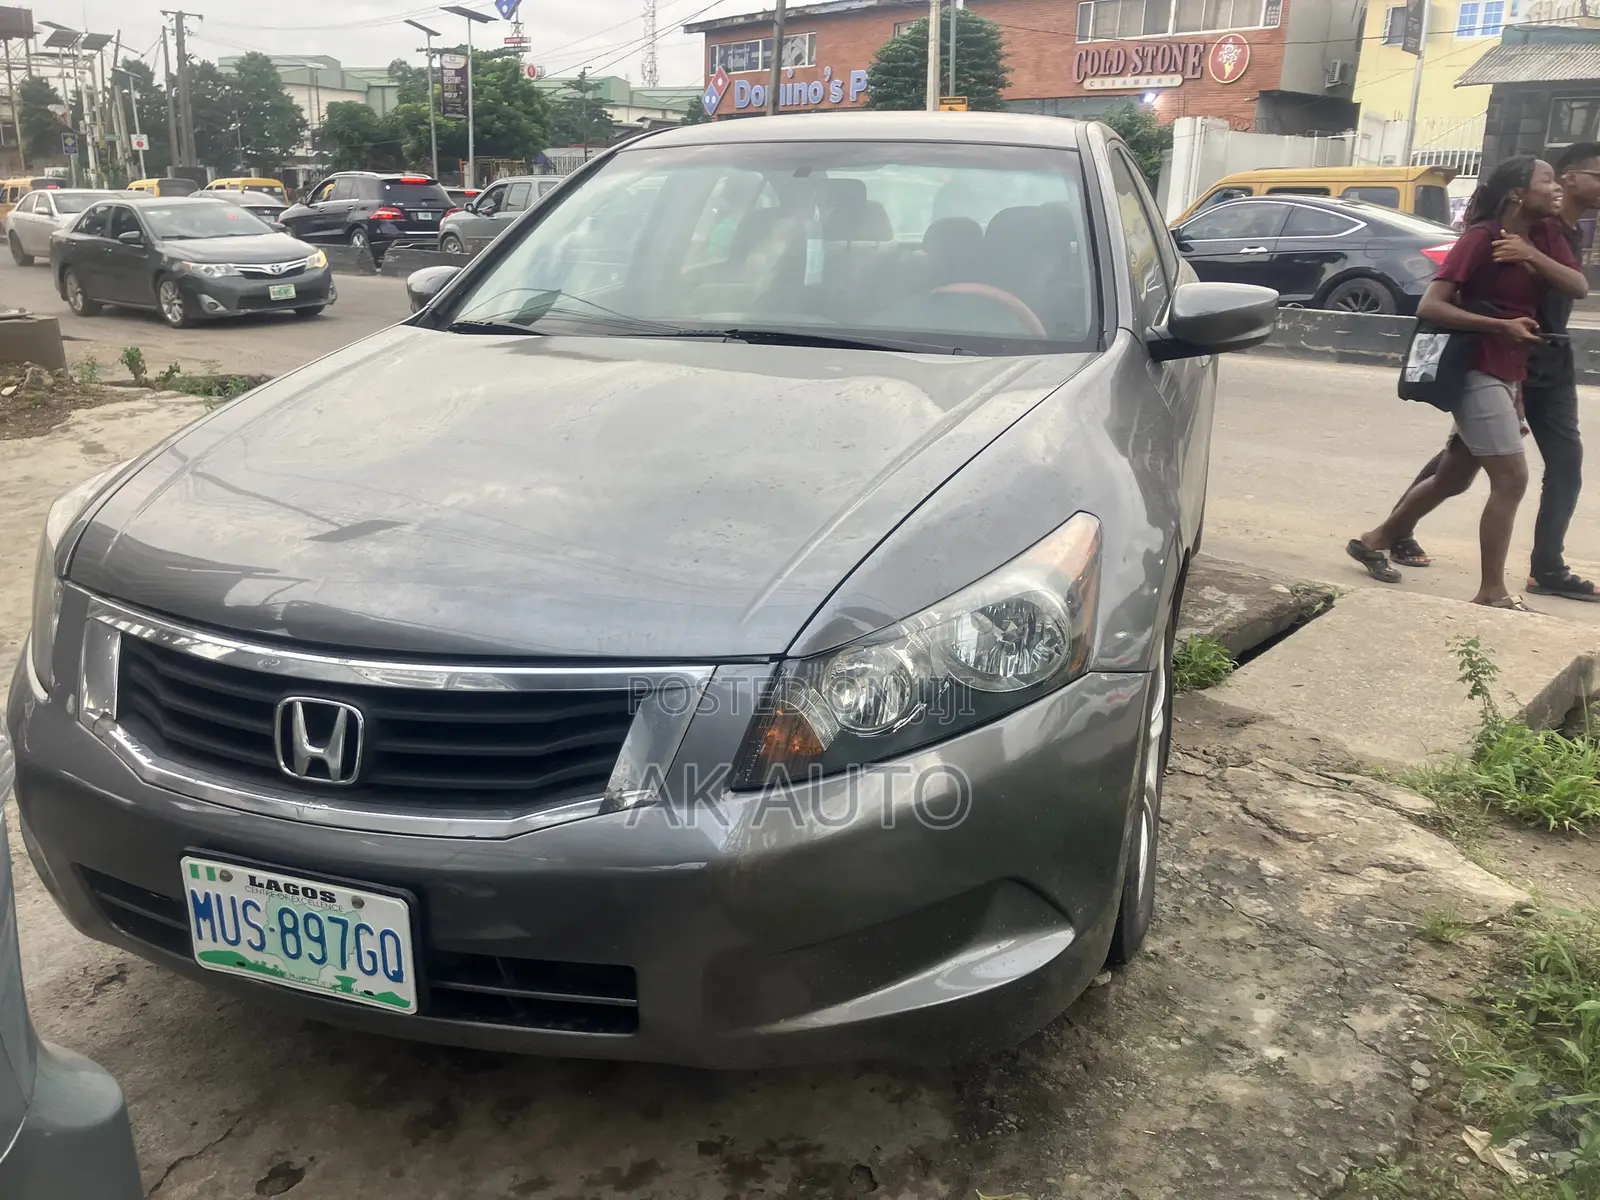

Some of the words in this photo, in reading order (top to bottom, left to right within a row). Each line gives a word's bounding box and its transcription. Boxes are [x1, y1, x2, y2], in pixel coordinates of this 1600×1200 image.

[1072, 49, 1126, 84] COLD
[1128, 43, 1206, 79] STONE
[1089, 76, 1176, 88] CREAMERY
[244, 885, 277, 899] CENTRE
[291, 895, 344, 913] EXCELLENCE
[248, 874, 337, 904] LAGOS
